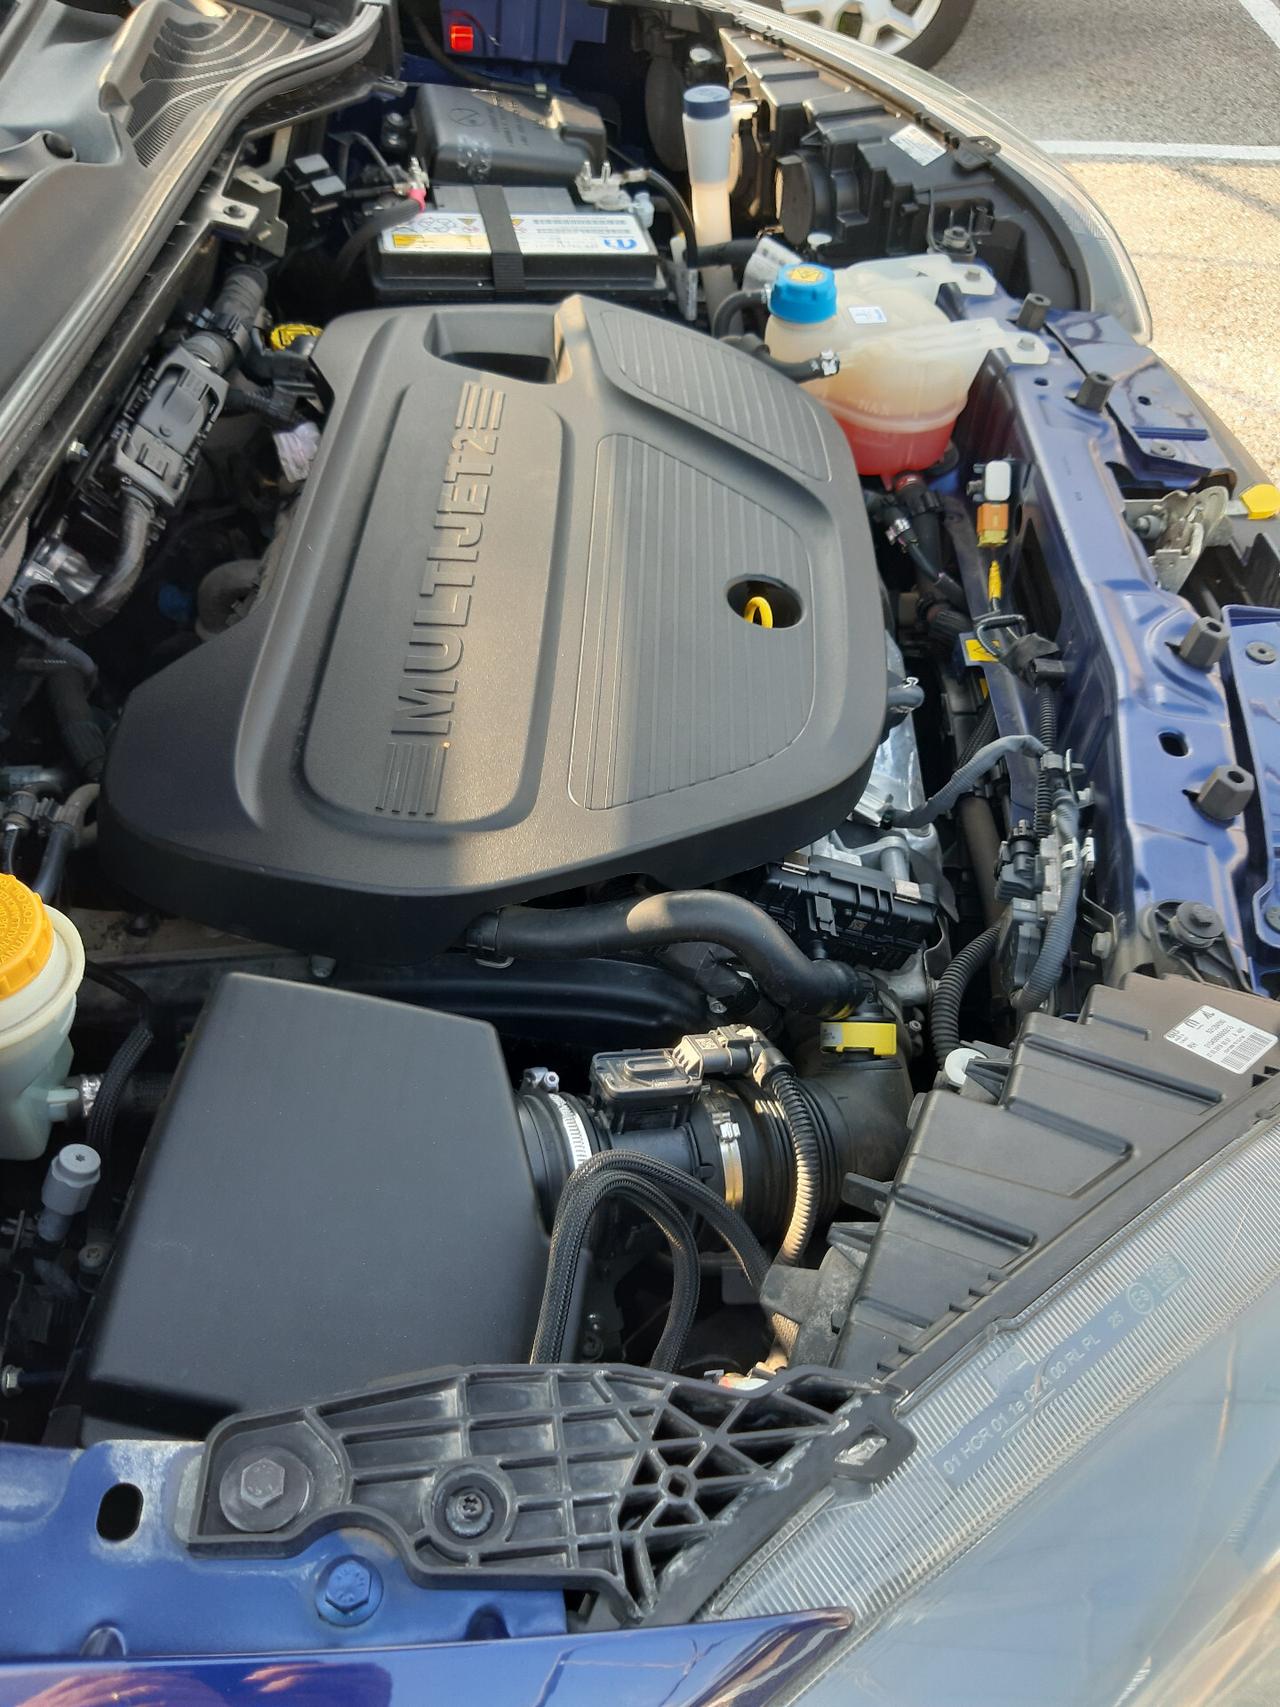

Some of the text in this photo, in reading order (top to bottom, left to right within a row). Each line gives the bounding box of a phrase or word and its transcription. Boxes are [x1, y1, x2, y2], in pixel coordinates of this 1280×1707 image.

[943, 1455, 961, 1475] 01
[961, 1428, 990, 1457] HCR
[992, 1412, 1008, 1432] 01
